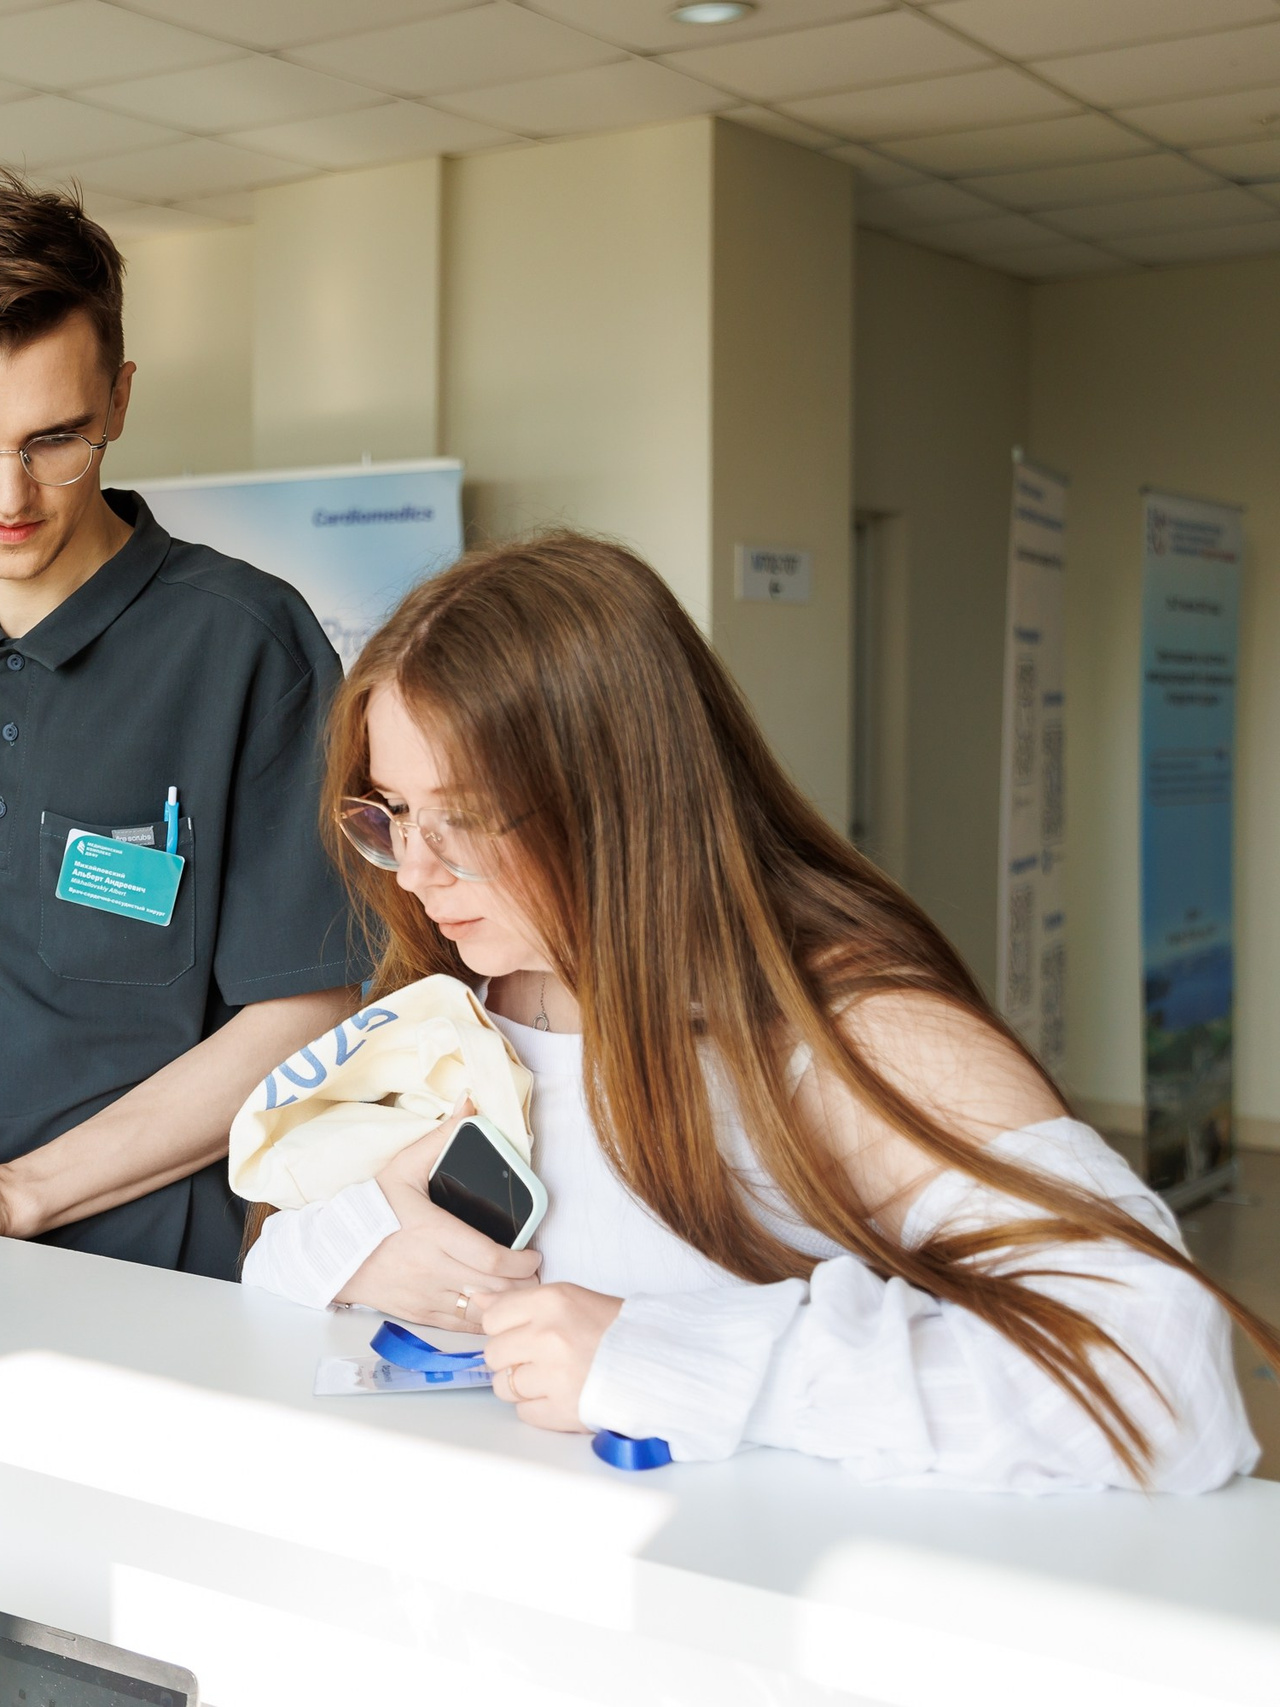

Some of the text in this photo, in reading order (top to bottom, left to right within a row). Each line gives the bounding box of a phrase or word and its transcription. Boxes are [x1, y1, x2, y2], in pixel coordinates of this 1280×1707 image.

[87, 842, 123, 855] МЕДИЦИНСКИЙ
[74, 860, 126, 879] Михайловский
[72, 868, 146, 893] Альберт Андреевич
[108, 887, 127, 897] Albert
[265, 1007, 399, 1110] 2025
